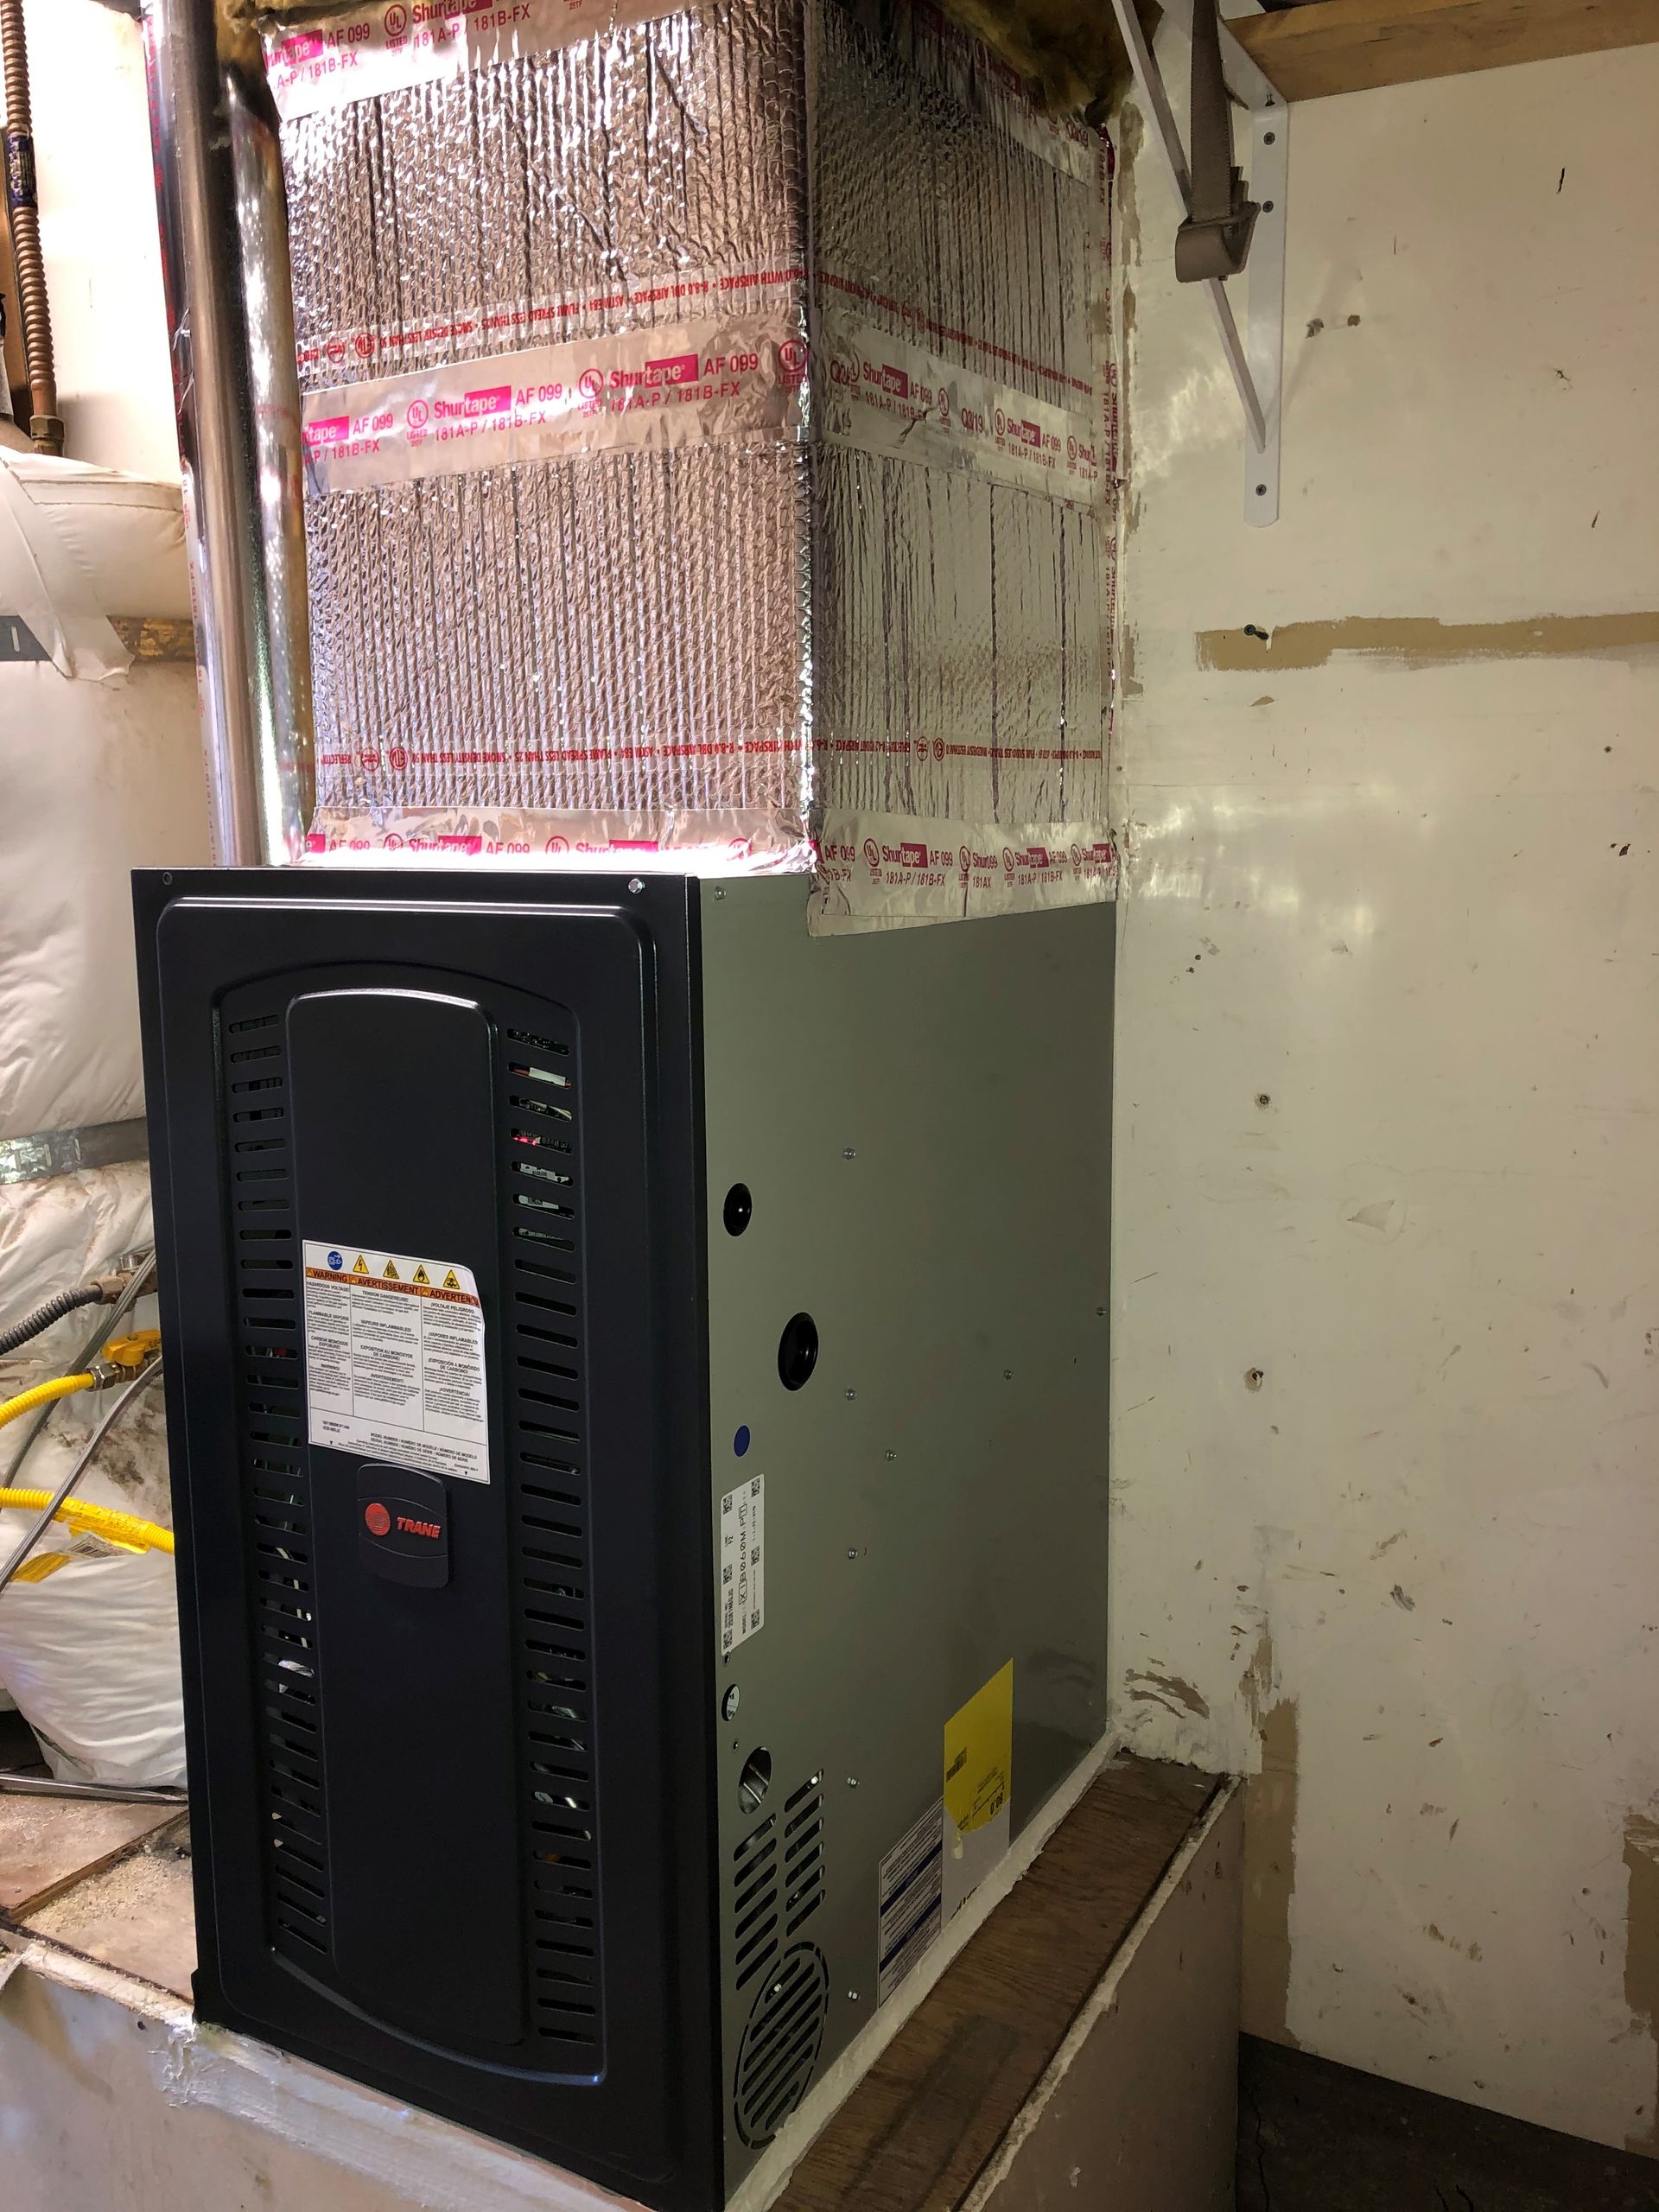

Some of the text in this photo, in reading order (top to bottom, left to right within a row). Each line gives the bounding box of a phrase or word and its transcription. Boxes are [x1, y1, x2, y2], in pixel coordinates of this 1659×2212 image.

[327, 22, 371, 48] AF 099
[414, 4, 531, 48] 181A-P 181B-FX
[308, 51, 358, 78] 181B-FX
[688, 279, 709, 293] R-8.0
[720, 273, 759, 289] AIRSPACE
[761, 270, 784, 284] WITH
[634, 285, 670, 303] AIRSPACE
[609, 353, 759, 391] Shurtape AF 099
[863, 361, 901, 391] Shurtape
[910, 382, 919, 399] AF
[920, 385, 932, 404] 099
[434, 383, 563, 419] Shurtape AF 099
[611, 393, 660, 412] 181A-P
[677, 382, 741, 404] 181B-FX
[866, 391, 891, 412] 181A-P
[353, 413, 393, 435] AF 099
[435, 423, 478, 442] 181A-P
[493, 411, 546, 432] 181B-FX
[962, 408, 982, 433] Q3/19
[332, 439, 380, 460] 181B-FX
[1042, 434, 1050, 448] AF
[1051, 435, 1061, 453] 099
[1008, 443, 1027, 461] 181A-P
[1033, 450, 1056, 469] 181B-FX
[525, 751, 543, 762] THAN
[562, 748, 588, 761] SPREAD
[697, 744, 713, 755] DBL
[714, 743, 734, 754] R-8.0
[745, 741, 782, 753] AIRSPACE
[824, 845, 837, 862] AF
[882, 845, 953, 868] Shurtape AF 099
[1049, 851, 1057, 864] AF
[1058, 851, 1068, 865] 099
[887, 871, 911, 886] 181A-P
[918, 872, 945, 887] 181B-FX
[1018, 873, 1036, 886] 181A-P
[1041, 870, 1063, 883] 181B-FX
[313, 1269, 347, 1282] WARNING
[358, 1279, 419, 1295] AVERTISSEMENT
[397, 1516, 441, 1539] TRANE
